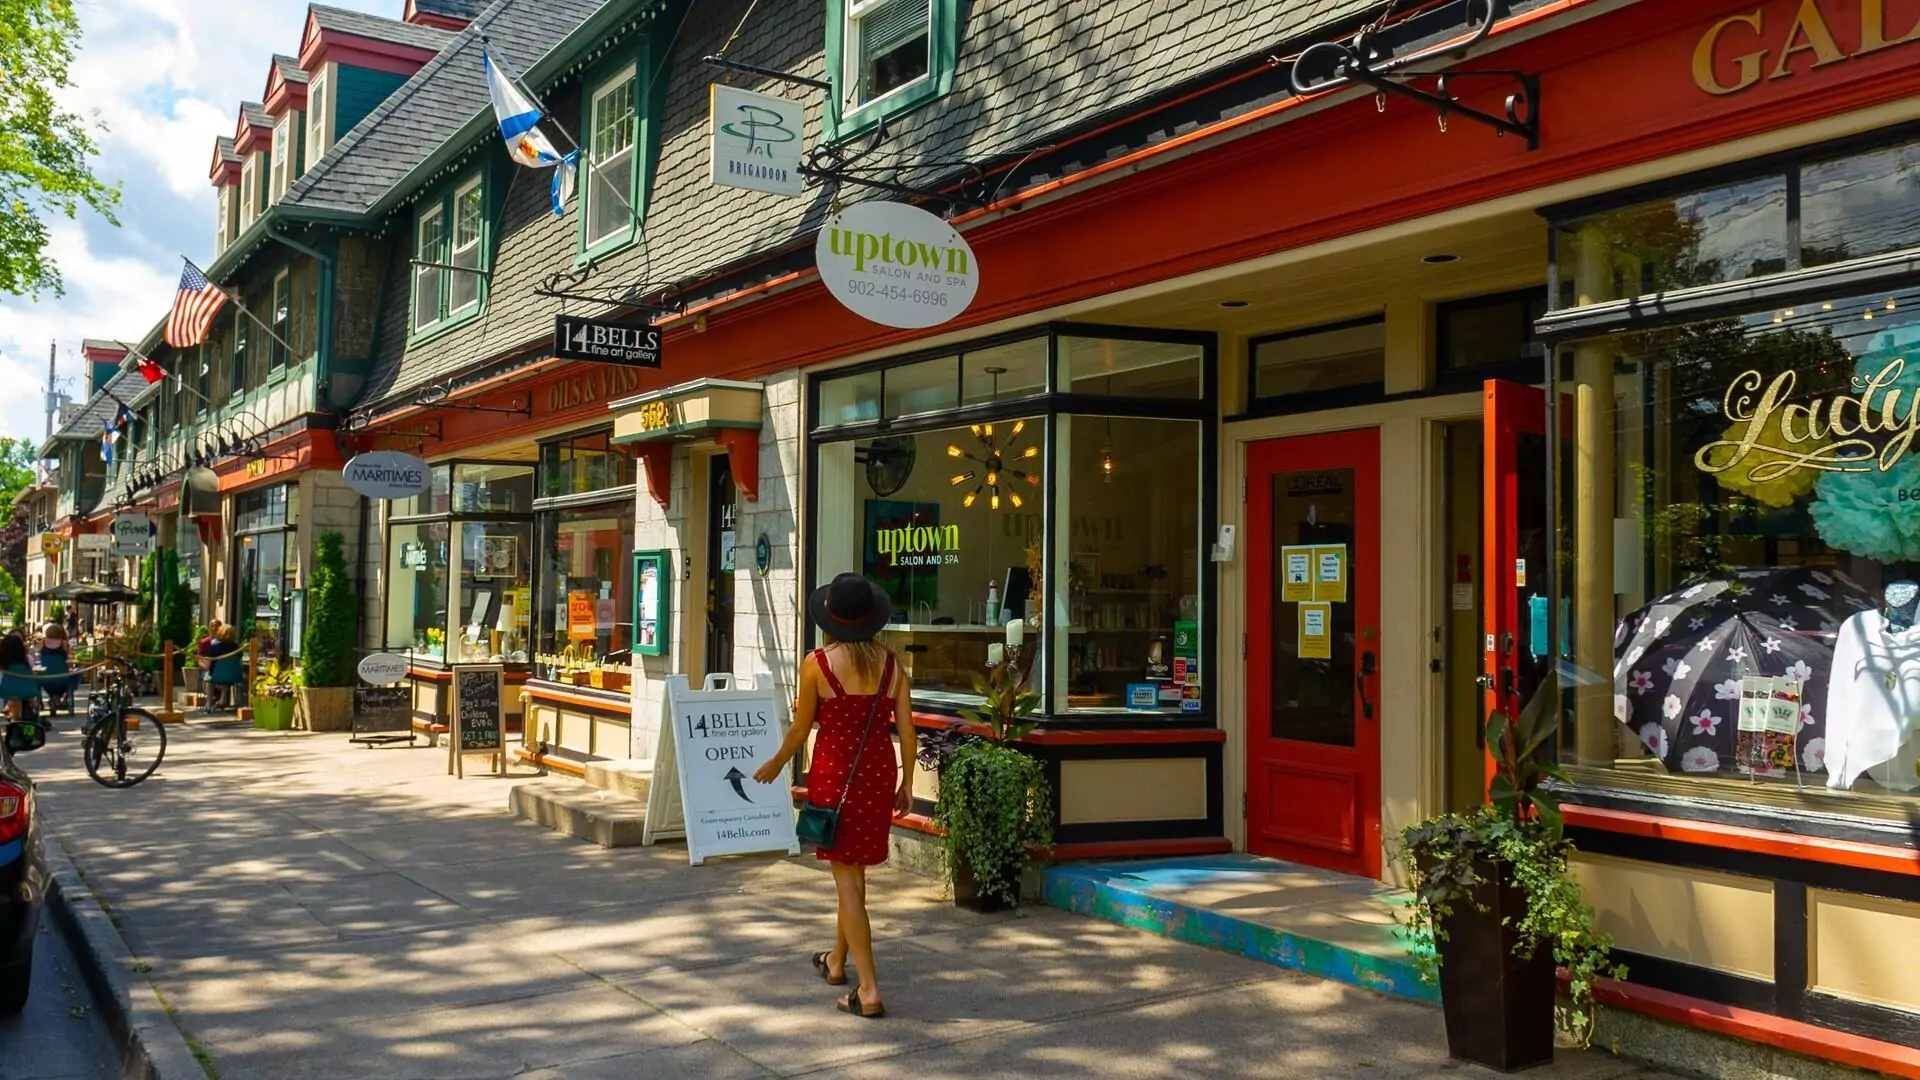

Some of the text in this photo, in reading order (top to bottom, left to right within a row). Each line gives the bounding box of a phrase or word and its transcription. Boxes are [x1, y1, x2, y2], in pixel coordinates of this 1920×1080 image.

[729, 161, 787, 182] BRIGADOON
[829, 227, 968, 275] uptown
[872, 265, 967, 288] SALON AND SPA
[848, 279, 948, 307] 902-454-6996
[562, 323, 658, 353] 14 BELLS
[591, 345, 656, 362] fine art gallery
[549, 377, 581, 412] OILS
[584, 374, 596, 401] &
[352, 469, 422, 483] MARITIMES
[876, 521, 960, 566] uptown
[900, 554, 959, 566] SALON AND SPA
[362, 664, 405, 674] MARITIMES
[686, 711, 767, 739] 14 BELLS
[728, 729, 740, 737] art
[742, 728, 768, 738] gallery
[705, 746, 754, 761] OPEN
[716, 828, 771, 841] 14Bells.com
